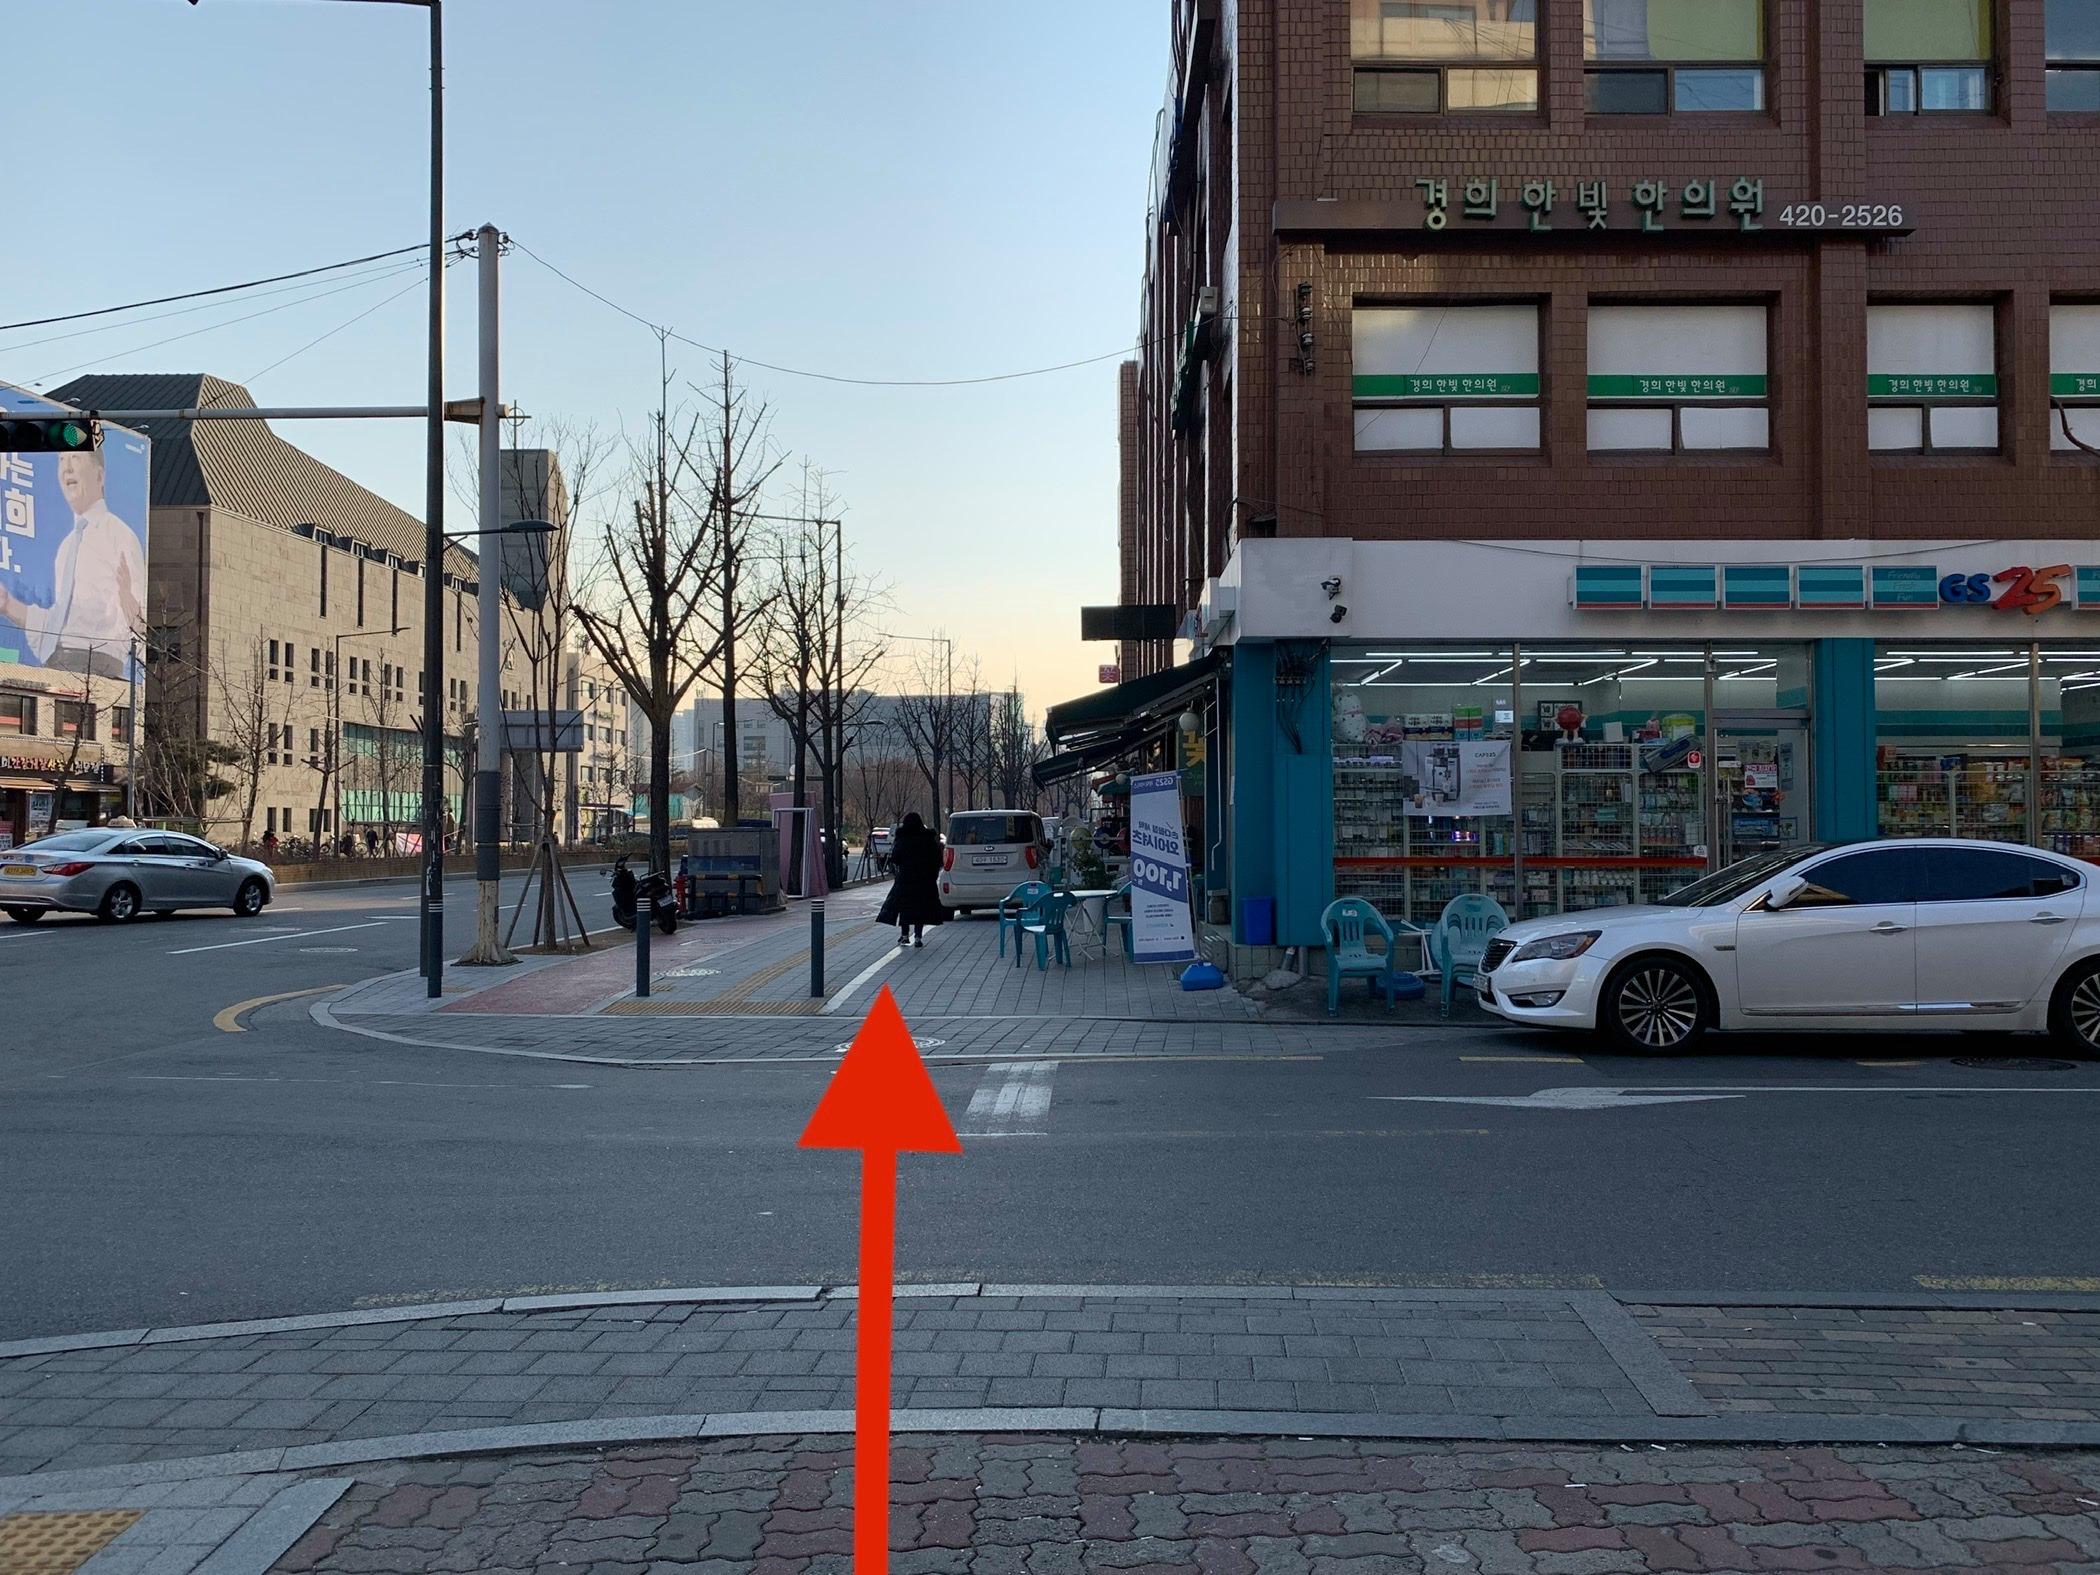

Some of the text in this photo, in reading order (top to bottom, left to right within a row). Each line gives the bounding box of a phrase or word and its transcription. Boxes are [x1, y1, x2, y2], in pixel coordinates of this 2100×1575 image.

[1414, 176, 1903, 232] 경희 한빛 한의원 420-2526
[1410, 378, 1432, 393] 경희
[1436, 378, 1458, 393] 한빛
[1462, 378, 1497, 393] 한의원
[1640, 379, 1661, 393] 경희
[1665, 379, 1687, 393] 한빛
[1691, 379, 1726, 393] 한의원
[1888, 379, 1909, 393] 경희
[1913, 379, 1933, 393] 한빛
[1937, 379, 1970, 393] 한의원
[2075, 378, 2097, 392] 경희
[0, 487, 35, 538] 한
[1939, 563, 2072, 615] GS25
